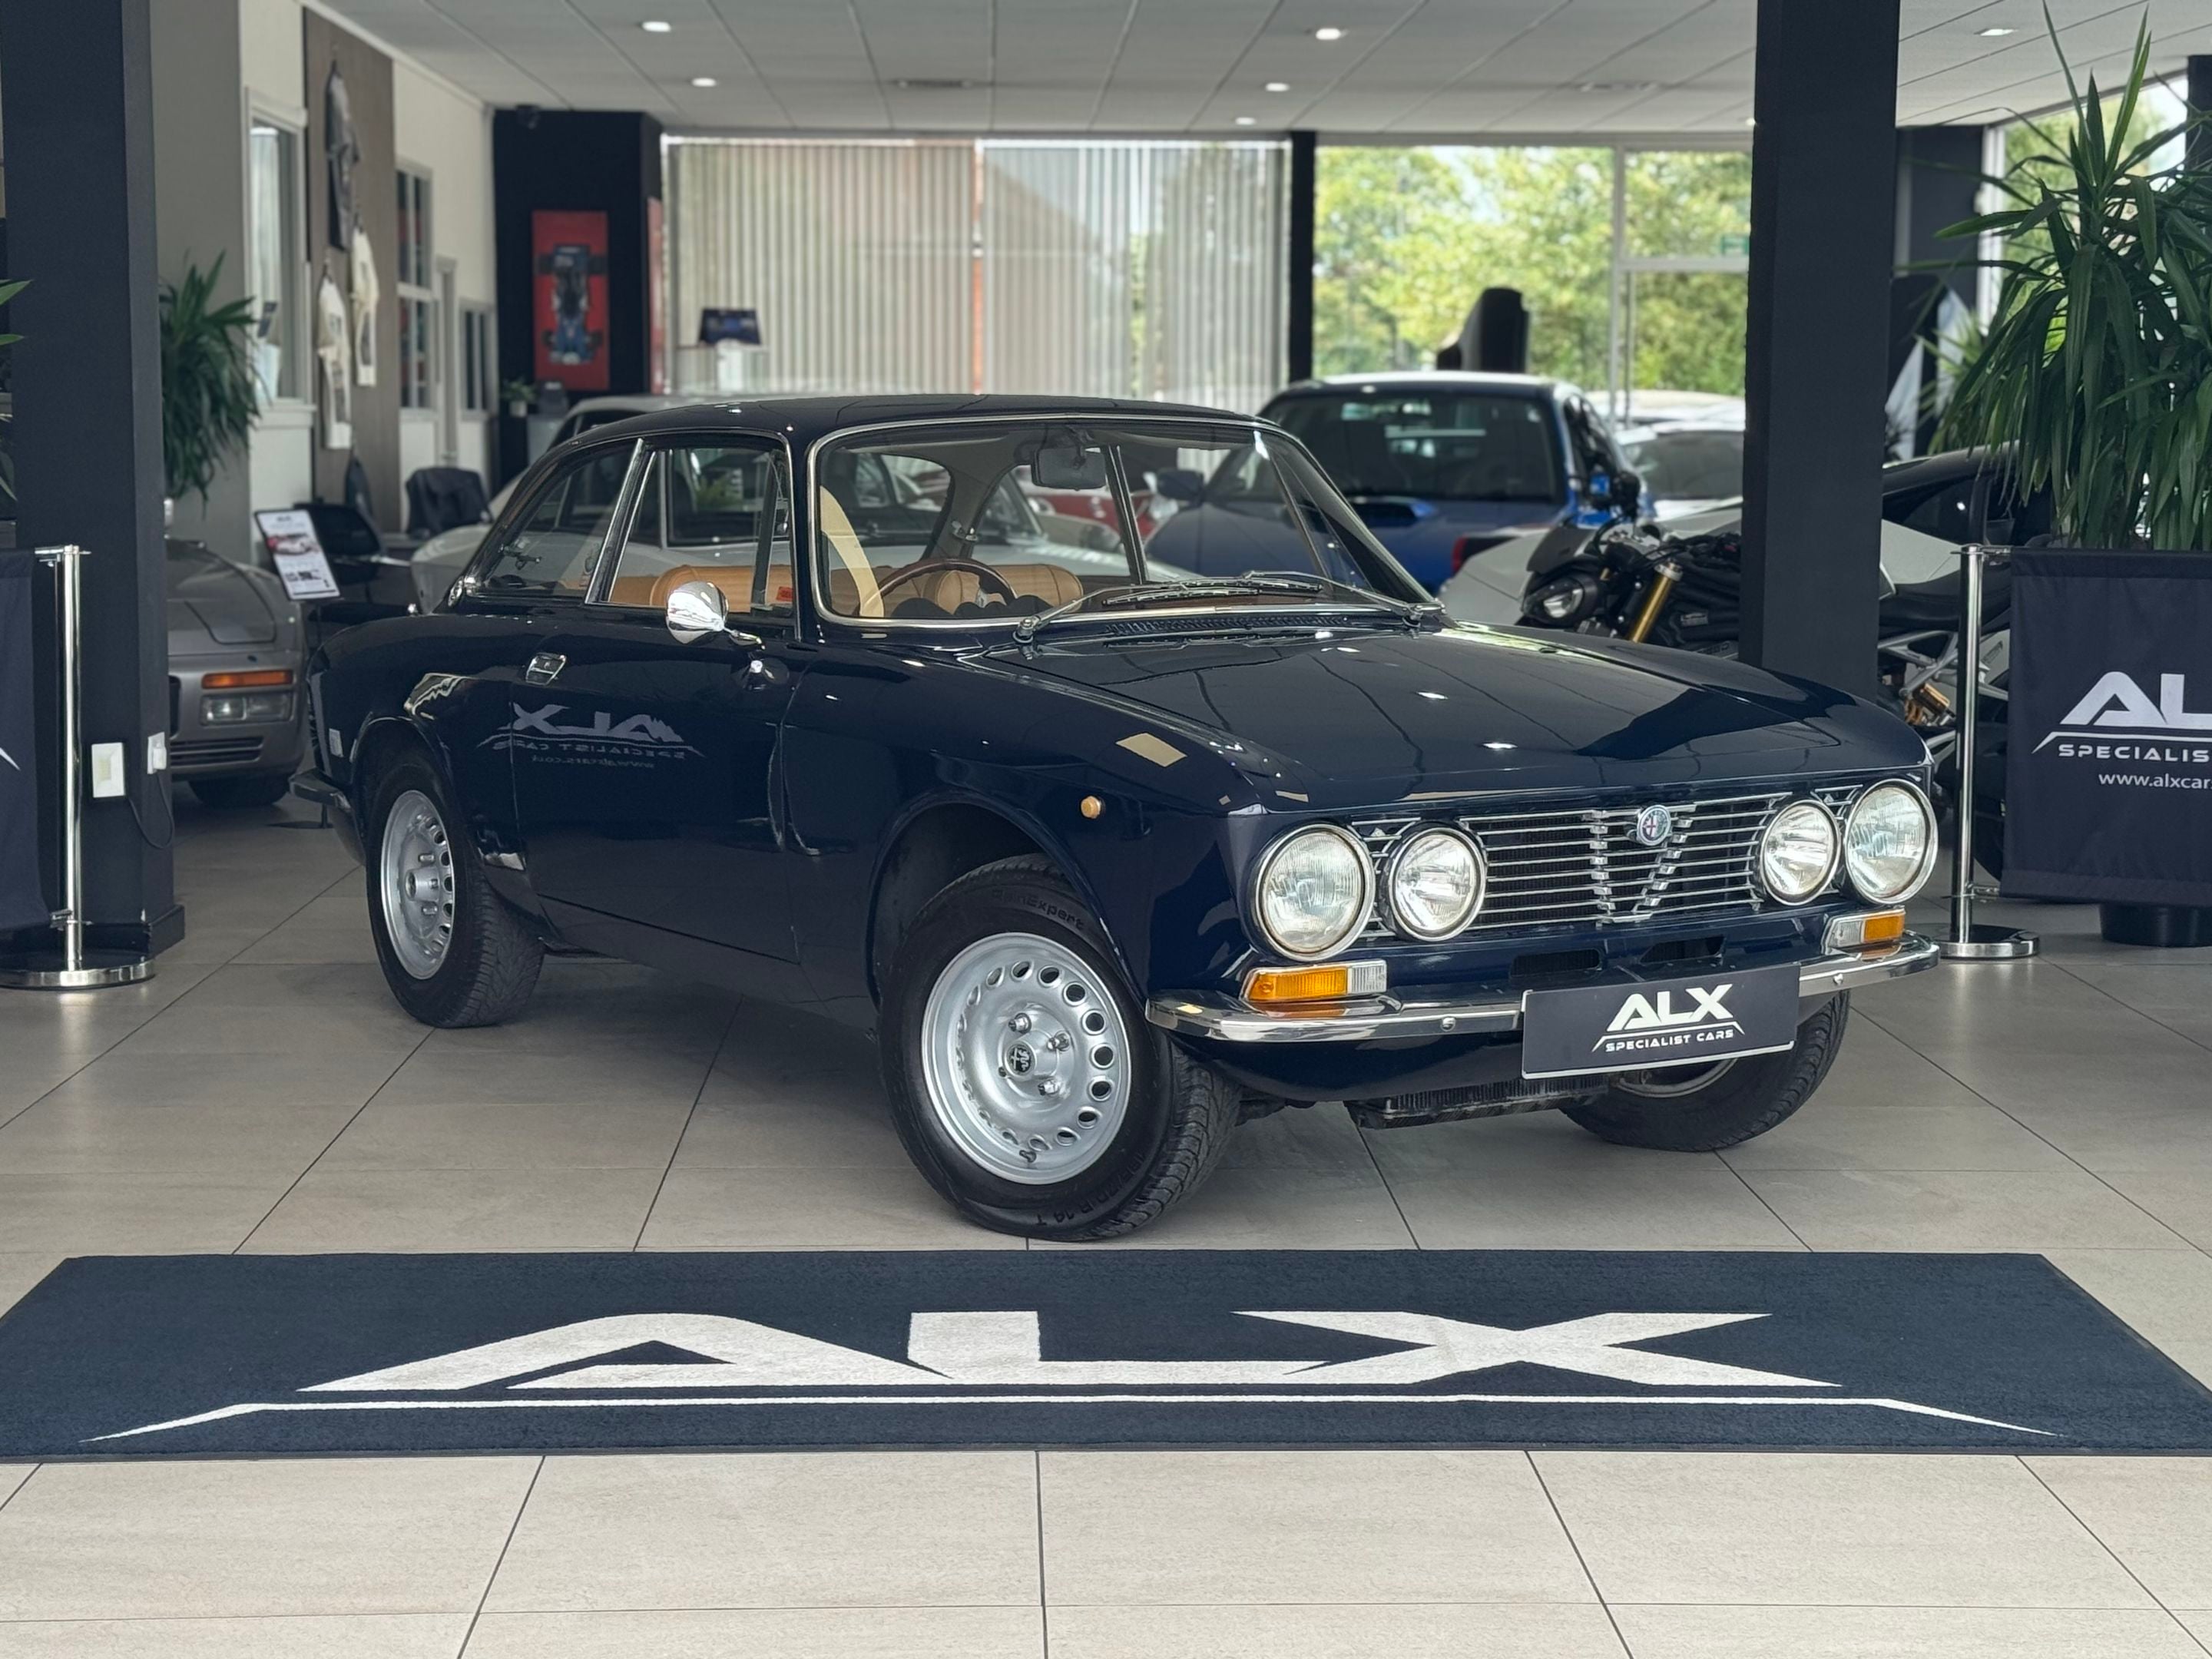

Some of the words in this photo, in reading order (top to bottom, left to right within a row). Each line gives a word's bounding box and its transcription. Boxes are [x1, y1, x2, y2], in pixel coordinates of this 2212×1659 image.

[1607, 983, 1734, 1031] ALX
[1605, 1034, 1691, 1052] SPECIALIST
[1697, 1029, 1734, 1042] CARS
[296, 1312, 1842, 1390] ALX
